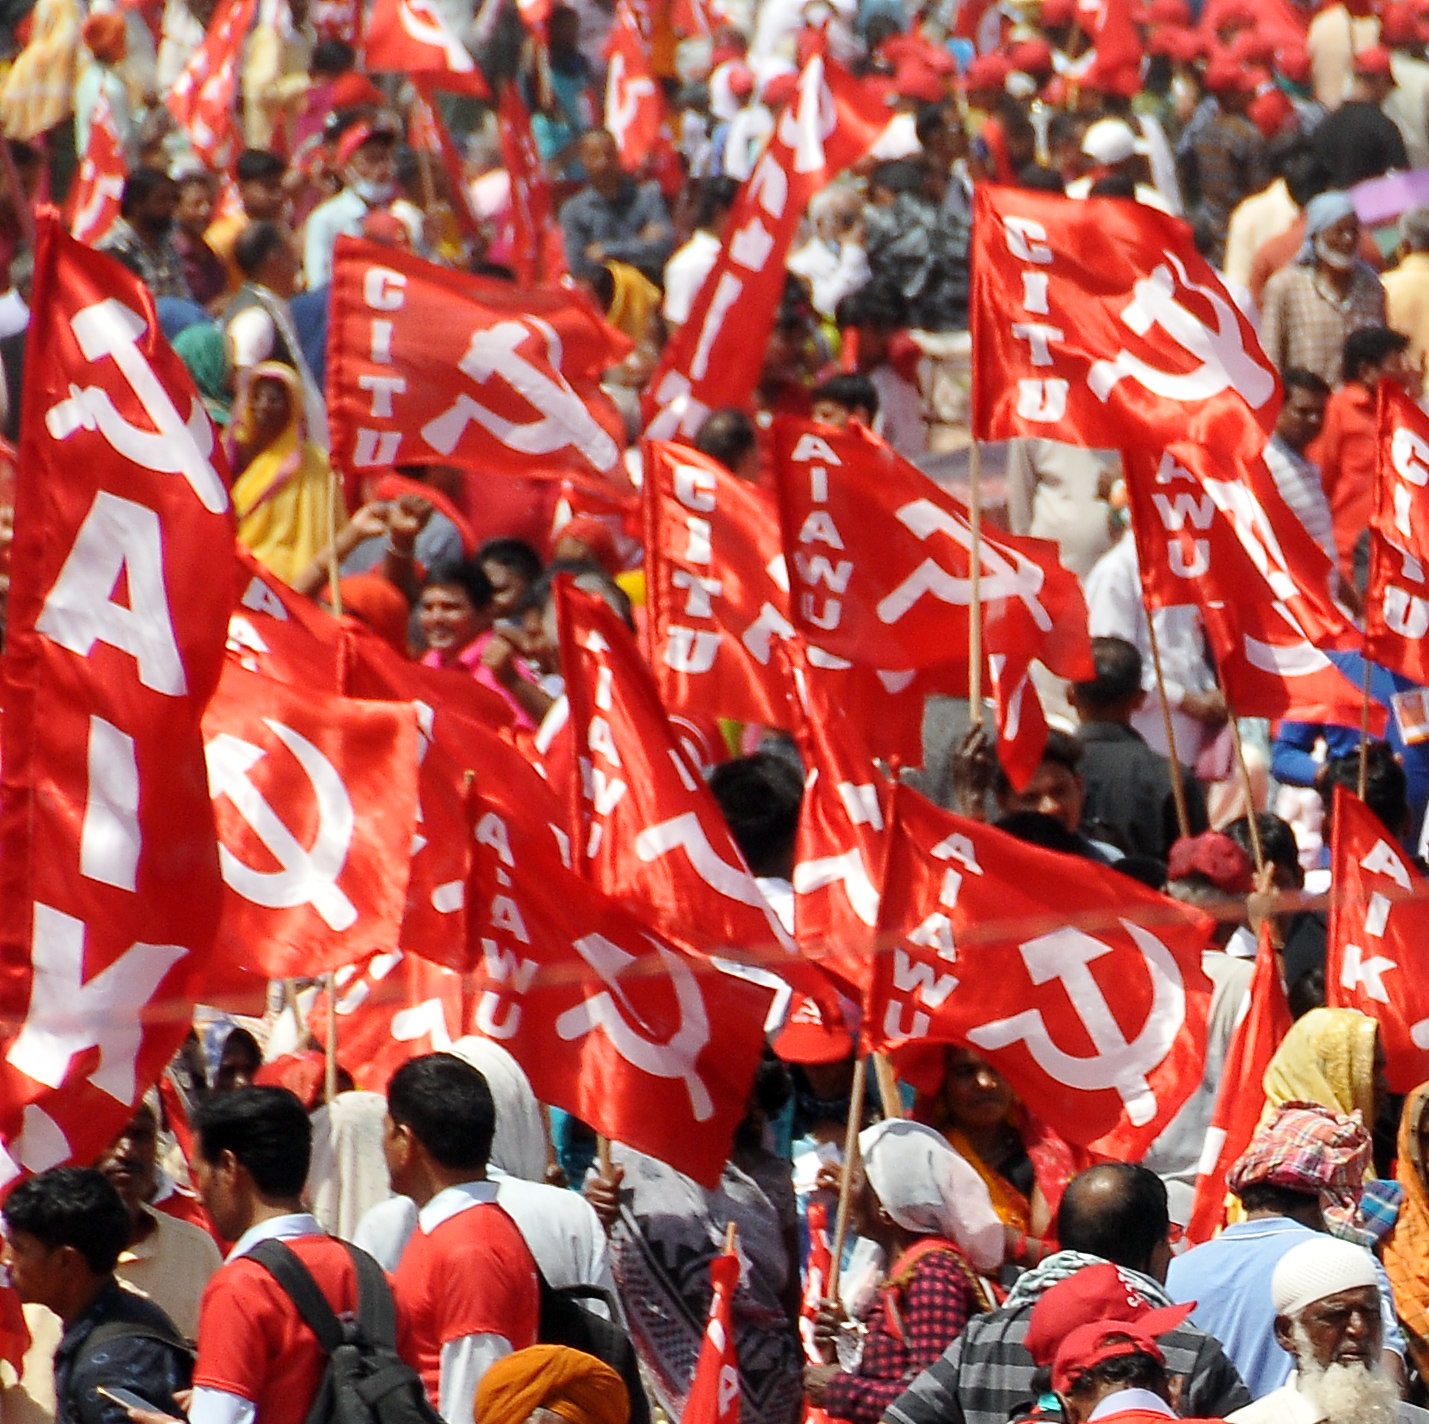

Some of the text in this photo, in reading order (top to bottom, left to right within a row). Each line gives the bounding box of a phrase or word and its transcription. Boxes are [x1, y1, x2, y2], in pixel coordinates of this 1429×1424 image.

[353, 269, 408, 468] CITU
[1001, 216, 1069, 423] CITU
[663, 463, 723, 675] CITU
[790, 432, 853, 632] AIAWU
[1152, 449, 1217, 580] AWU
[474, 811, 539, 1040] AIAWU
[883, 833, 983, 1040] AIAWU
[1340, 838, 1413, 1003] AIK
